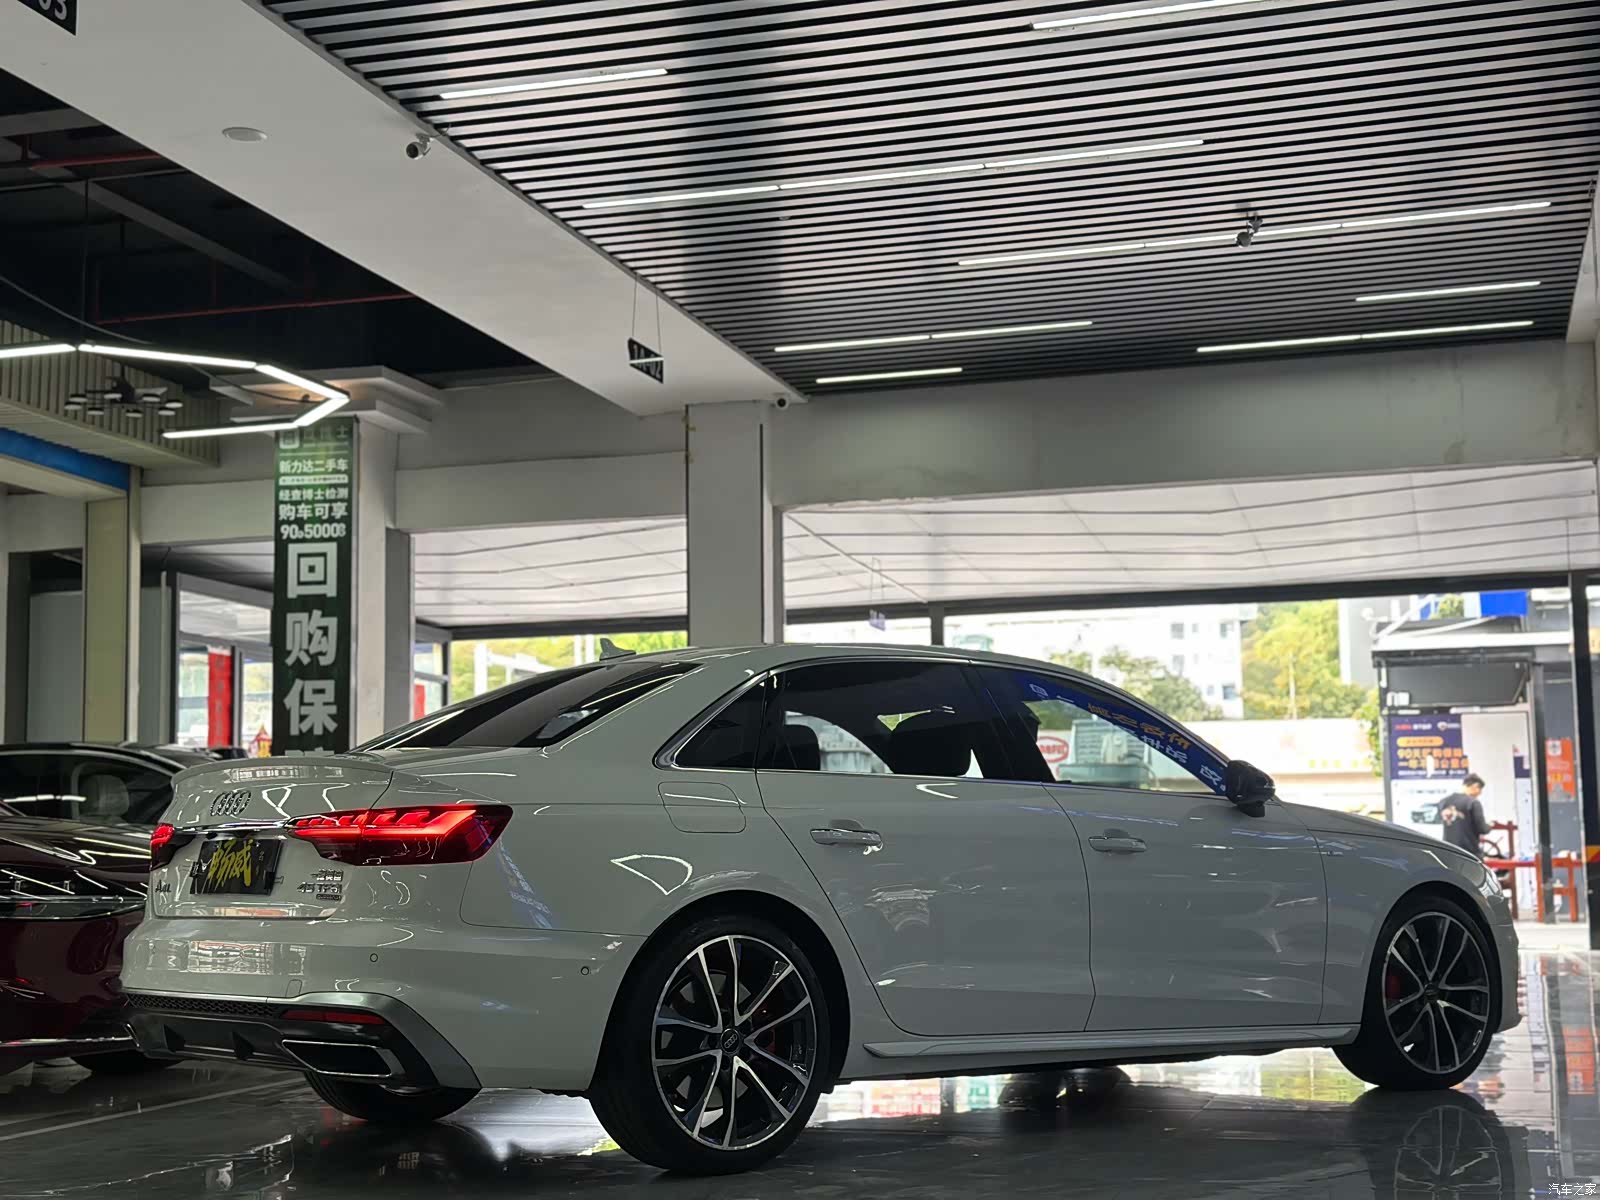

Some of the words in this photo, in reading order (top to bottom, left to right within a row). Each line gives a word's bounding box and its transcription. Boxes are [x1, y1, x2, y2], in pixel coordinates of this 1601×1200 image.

[279, 458, 349, 474] 新力达二手车
[278, 502, 349, 521] 购车可享
[284, 541, 339, 755] 回购保
